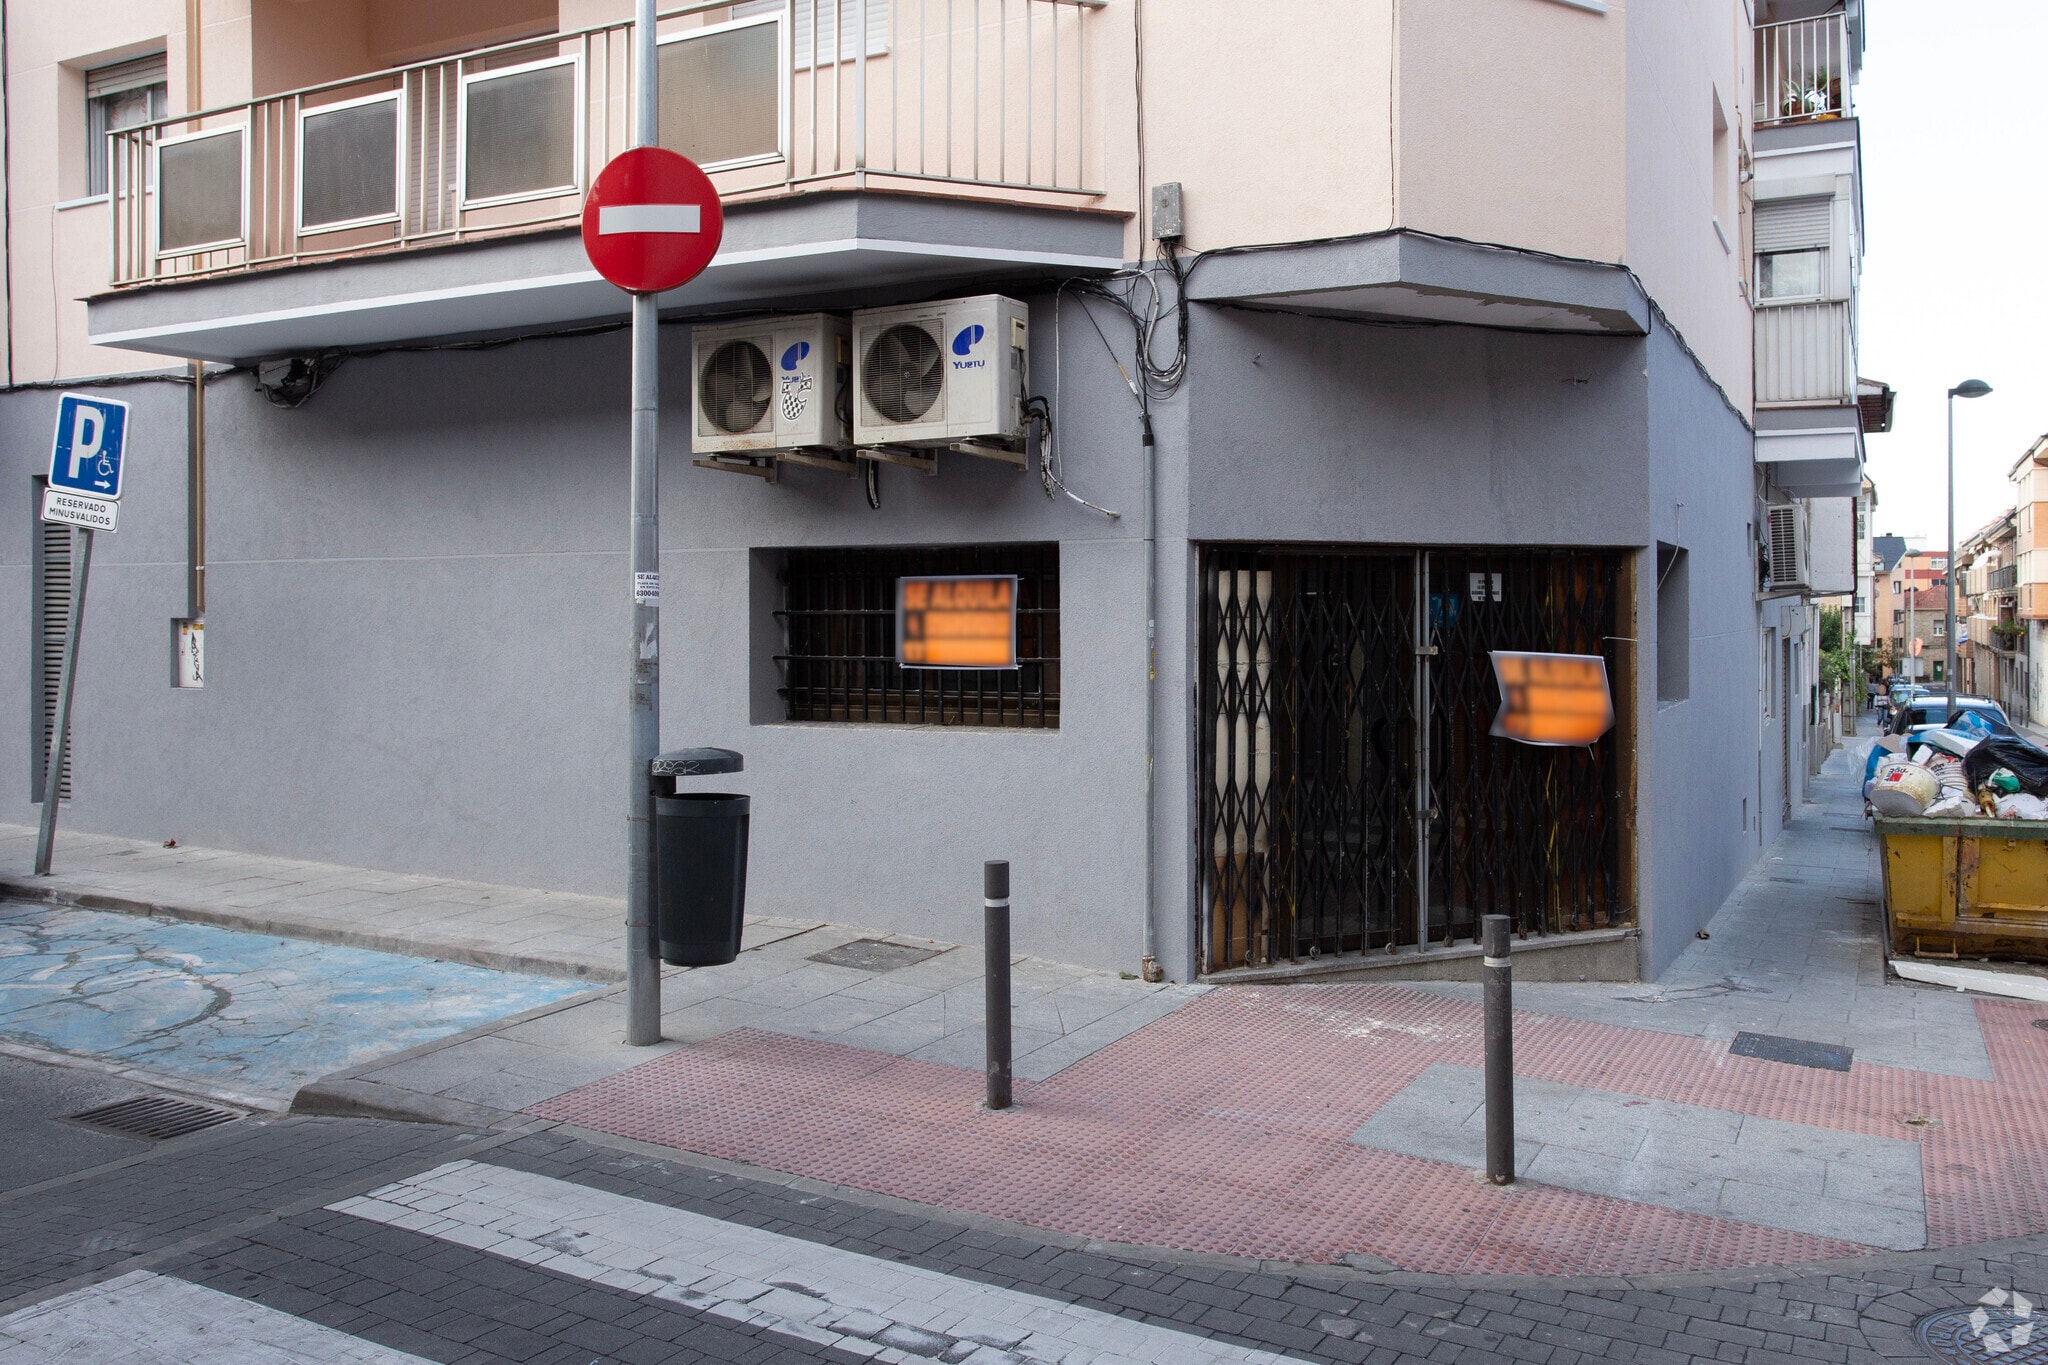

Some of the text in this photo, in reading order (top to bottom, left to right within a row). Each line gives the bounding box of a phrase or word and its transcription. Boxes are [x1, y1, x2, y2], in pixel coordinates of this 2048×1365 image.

[68, 404, 104, 479] P
[56, 497, 106, 514] RESERVADO
[49, 507, 111, 526] MINUSVALIDOS
